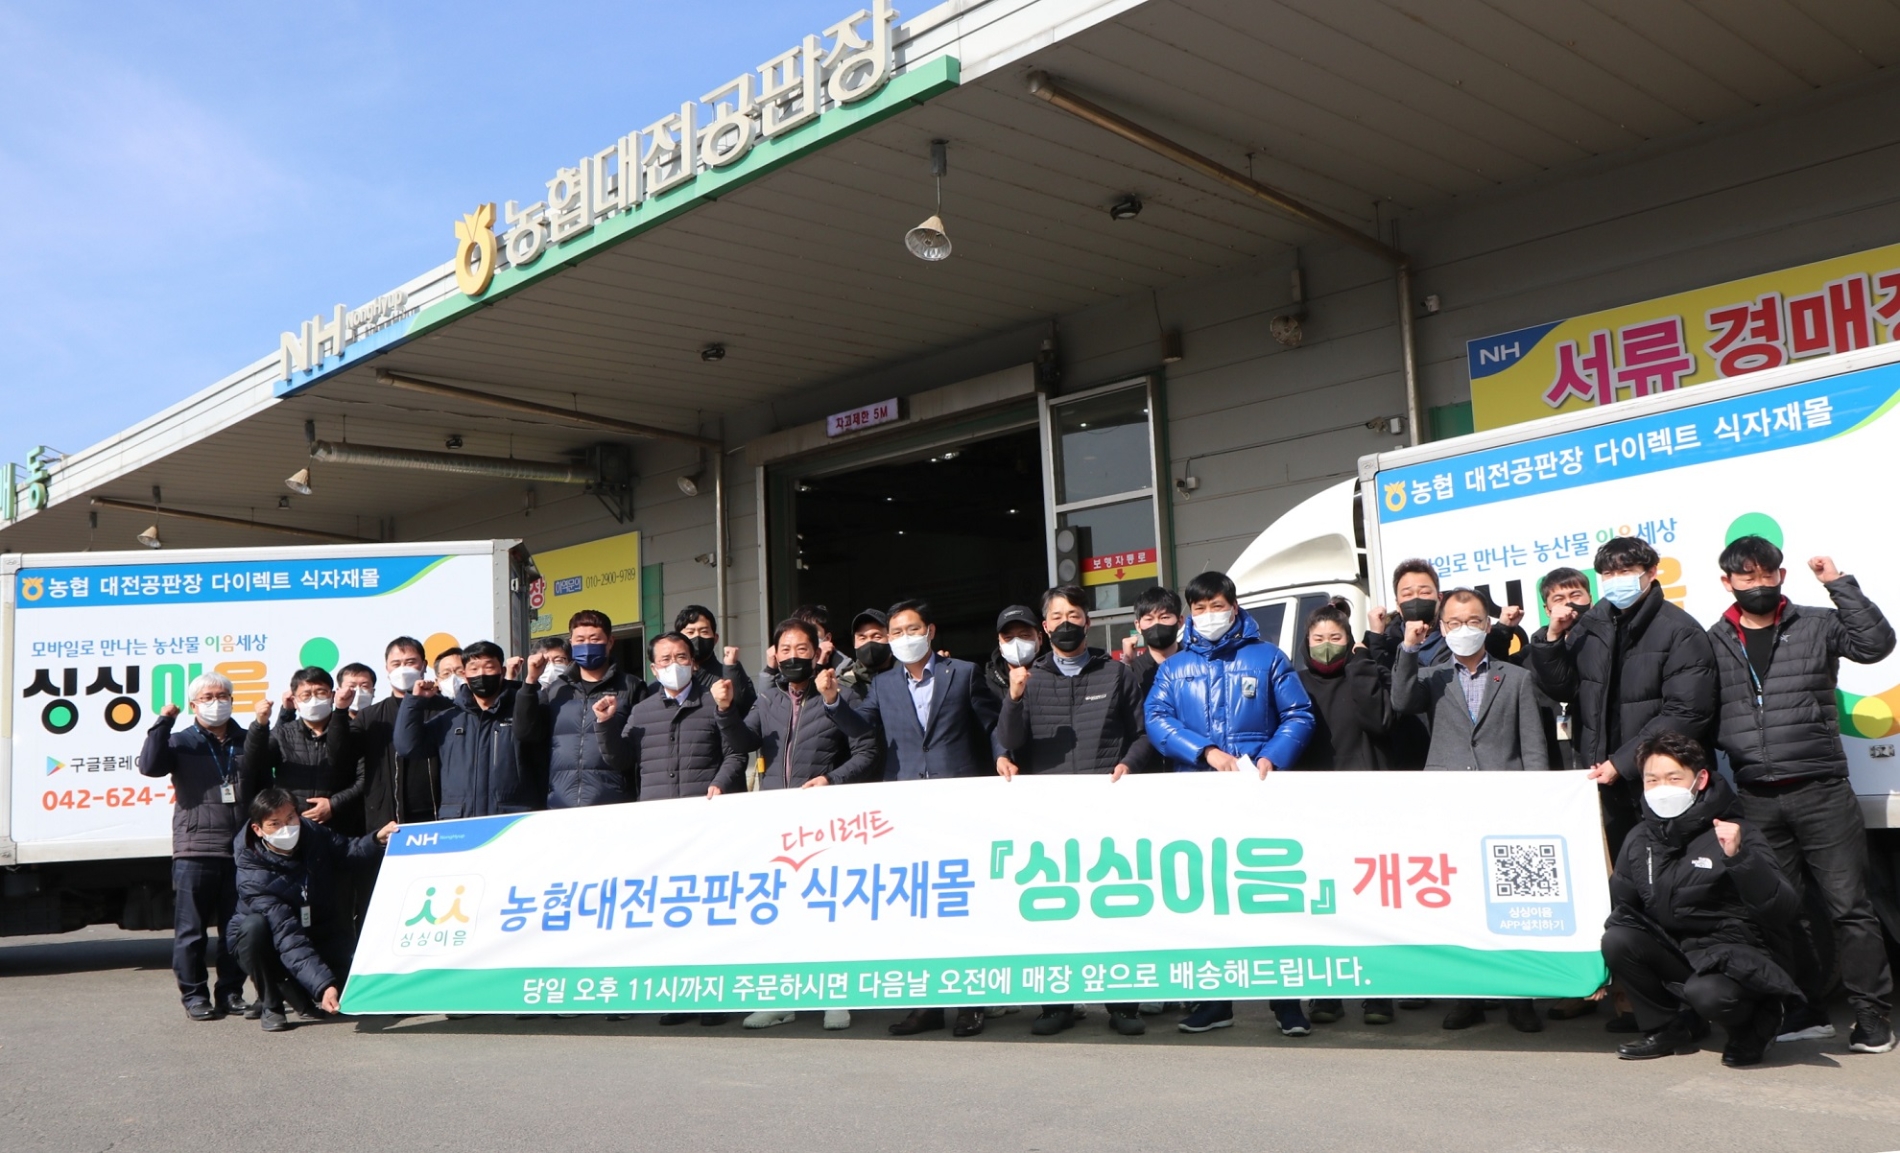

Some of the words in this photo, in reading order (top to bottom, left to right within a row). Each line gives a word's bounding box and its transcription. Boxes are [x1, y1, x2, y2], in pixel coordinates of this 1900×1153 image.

[505, 0, 900, 267] 농협대전공판장
[280, 303, 346, 382] NH
[1479, 341, 1521, 366] NH
[1545, 316, 1692, 406] 서류
[873, 405, 888, 419] 5M
[1410, 472, 1454, 505] 농협
[1465, 449, 1584, 493] 대전공판장
[1594, 423, 1702, 467] 다이렉트
[1712, 395, 1834, 443] 식자재몰
[1093, 552, 1147, 570] 보행자통로
[1473, 545, 1528, 573] 만나는
[1532, 532, 1590, 561] 농산물
[48, 576, 90, 599] 농협
[100, 575, 203, 597] 대전공판장
[211, 570, 292, 593] 다이렉트
[300, 568, 380, 591] 식자재몰
[31, 639, 95, 659] 모바일로
[100, 637, 148, 657] 만나는
[152, 636, 201, 655] 농산물
[205, 634, 268, 653] 이음세상
[405, 832, 439, 847] NH
[780, 809, 895, 852] 다이렉트
[499, 868, 787, 933] 농협대전공판장
[800, 858, 976, 923] 식자재몰
[1352, 852, 1458, 910] 개장
[400, 929, 467, 948] 싱싱이음
[1499, 919, 1565, 932] APP설치하기
[522, 977, 566, 1005] 당일
[573, 976, 619, 1004] 오후
[628, 974, 725, 1003] 11시까지
[731, 971, 849, 1001] 주문하시면
[858, 968, 931, 999] 다음날
[937, 965, 1012, 997] 오전에
[1021, 963, 1073, 994] 매장
[1080, 961, 1160, 991] 앞으로
[1169, 956, 1372, 989] 배송해드립니다.
